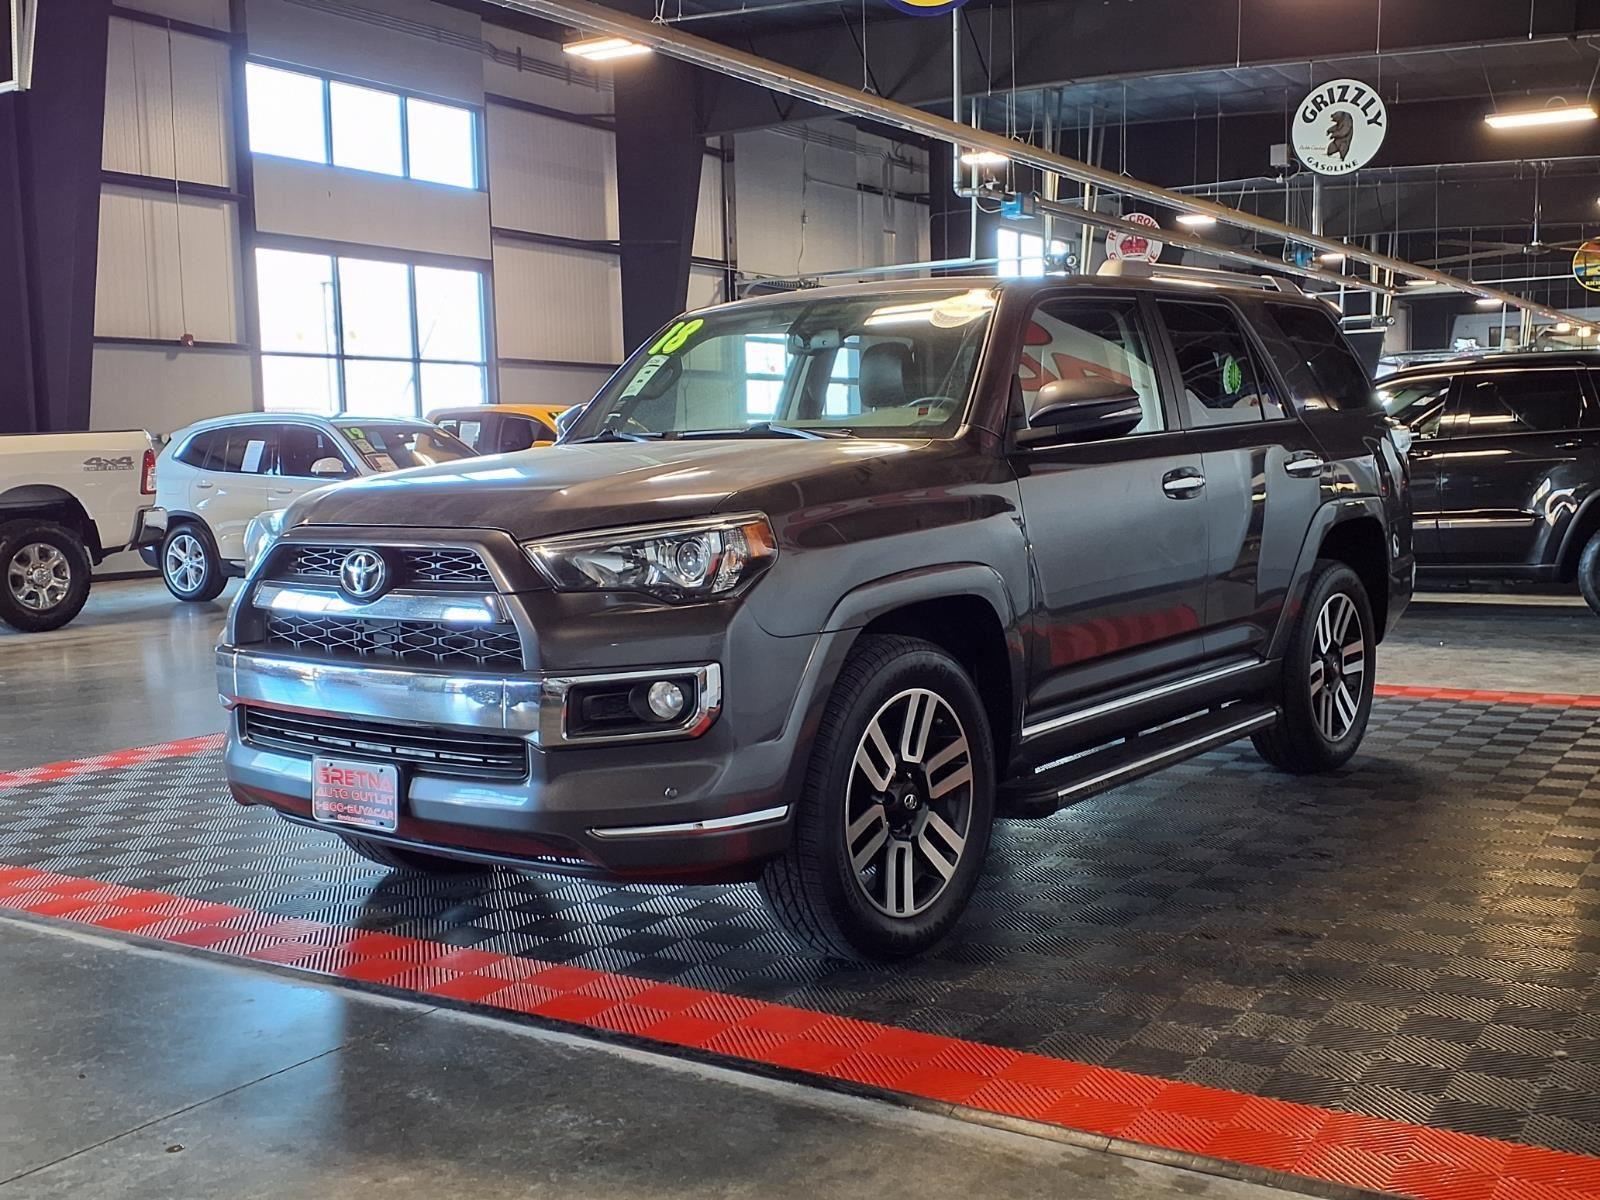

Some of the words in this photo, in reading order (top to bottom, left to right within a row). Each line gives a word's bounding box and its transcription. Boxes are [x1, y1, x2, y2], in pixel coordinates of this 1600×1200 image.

[1301, 84, 1383, 128] GRIZZLY
[1306, 156, 1359, 173] GASOLINE
[647, 318, 704, 355] 18
[342, 427, 366, 440] 19
[318, 766, 394, 793] GRETNA
[315, 786, 349, 800] AUTO
[351, 789, 394, 806] OUTLET
